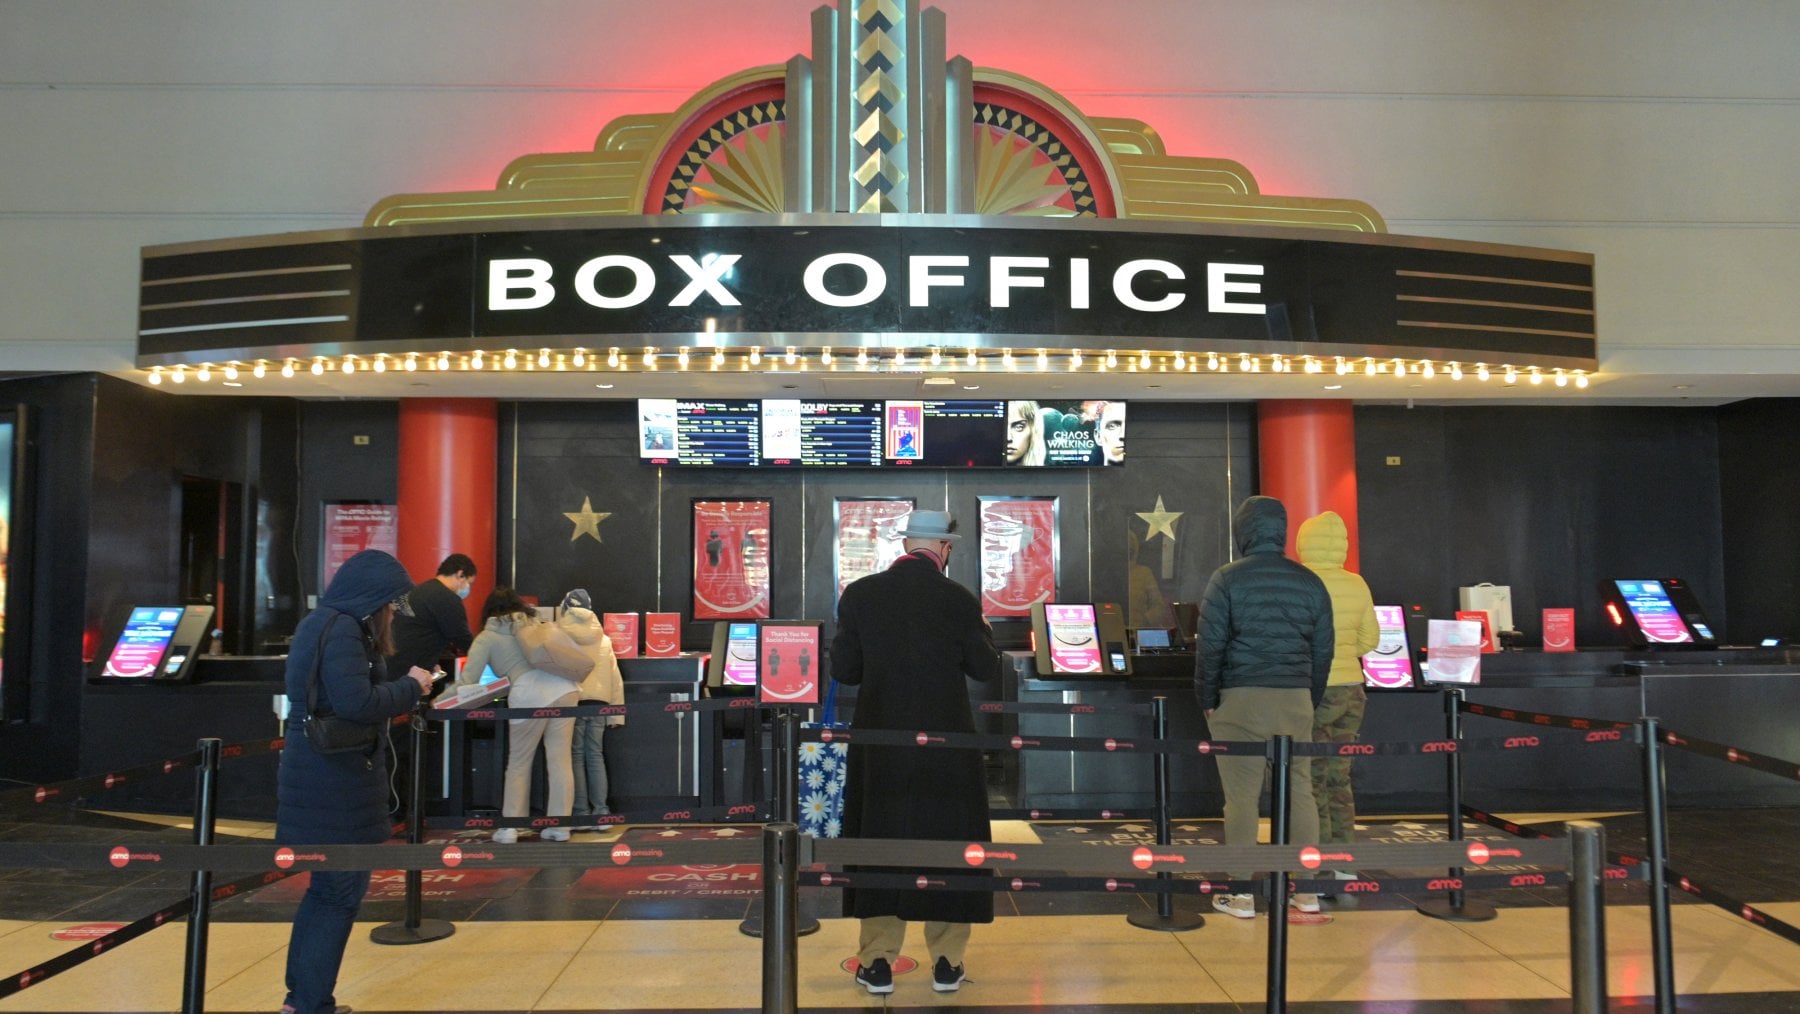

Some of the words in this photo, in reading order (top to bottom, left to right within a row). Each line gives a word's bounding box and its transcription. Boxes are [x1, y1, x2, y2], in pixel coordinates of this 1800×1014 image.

[489, 254, 742, 310] BOX
[803, 253, 1266, 315] OFFICE
[1053, 431, 1089, 440] CHAOS
[1047, 440, 1095, 449] WALKING
[784, 637, 814, 645] Distancing
[1082, 838, 1219, 846] TICKTS
[1370, 836, 1509, 844] TICKTS
[647, 873, 758, 881] CASH
[1603, 868, 1628, 879] mc
